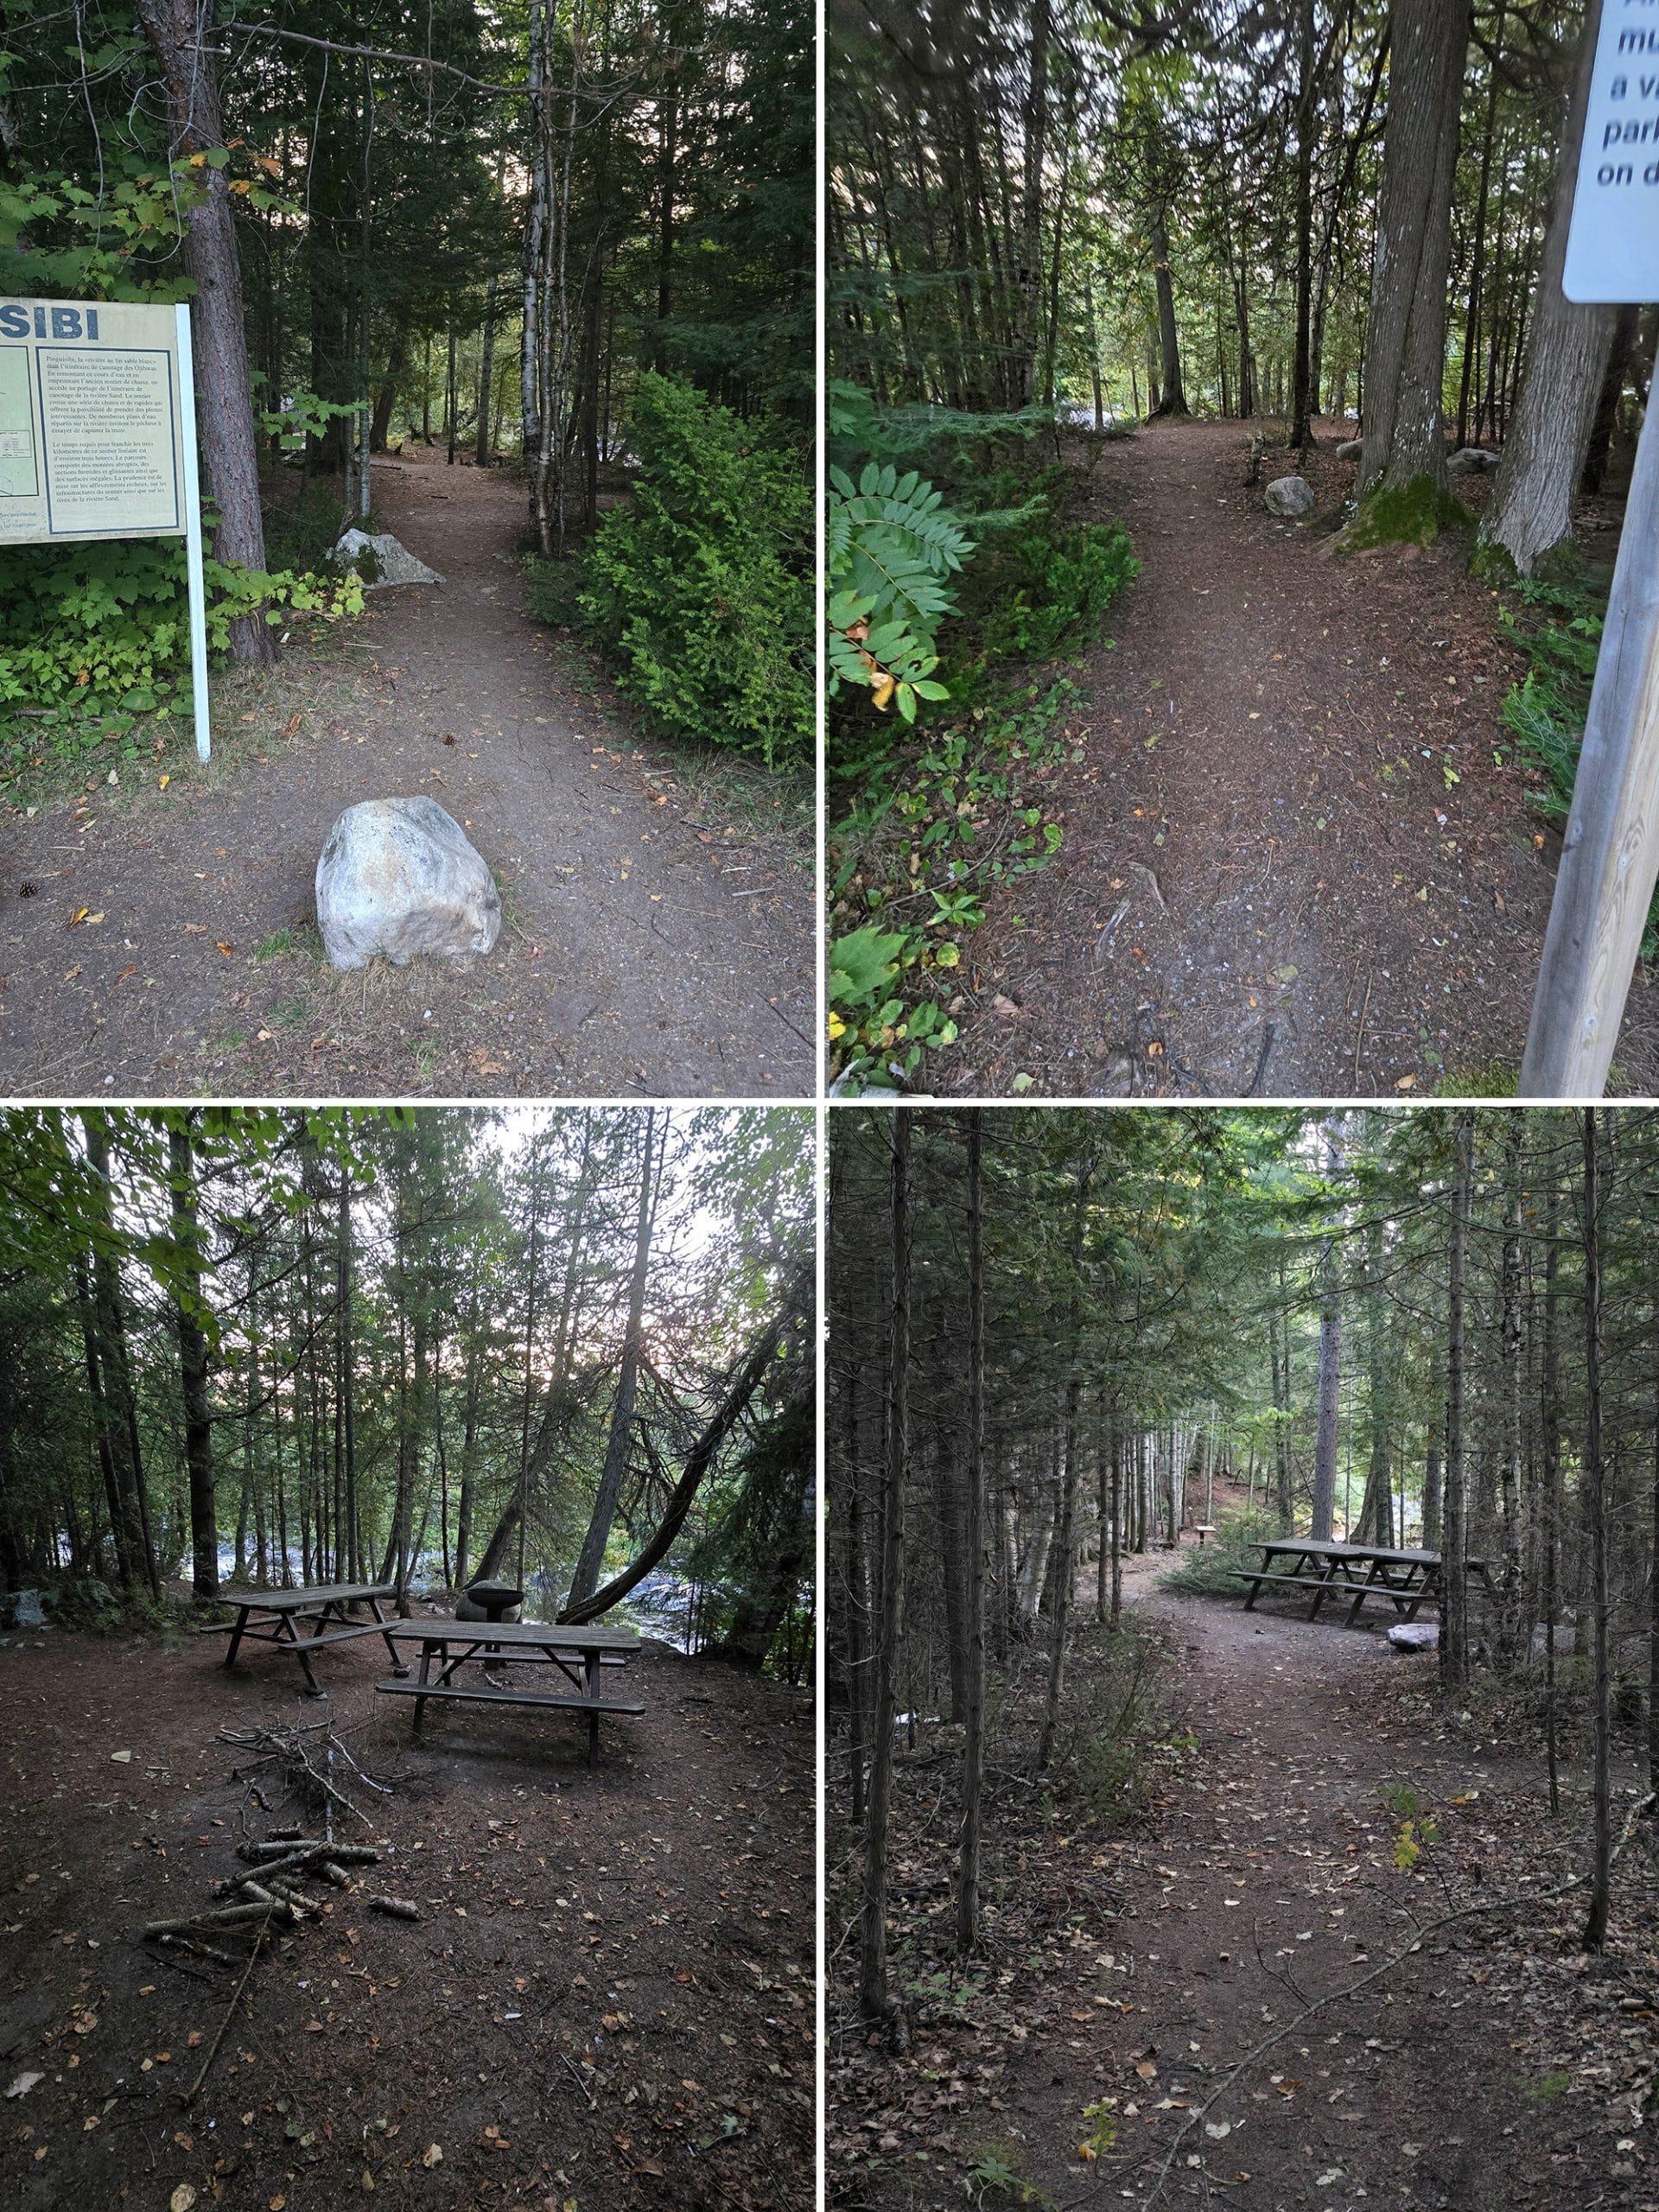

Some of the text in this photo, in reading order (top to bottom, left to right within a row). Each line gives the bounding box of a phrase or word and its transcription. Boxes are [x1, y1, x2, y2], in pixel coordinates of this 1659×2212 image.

[1610, 73, 1627, 100] a
[1597, 162, 1633, 187] on
[0, 305, 99, 340] SIBI
